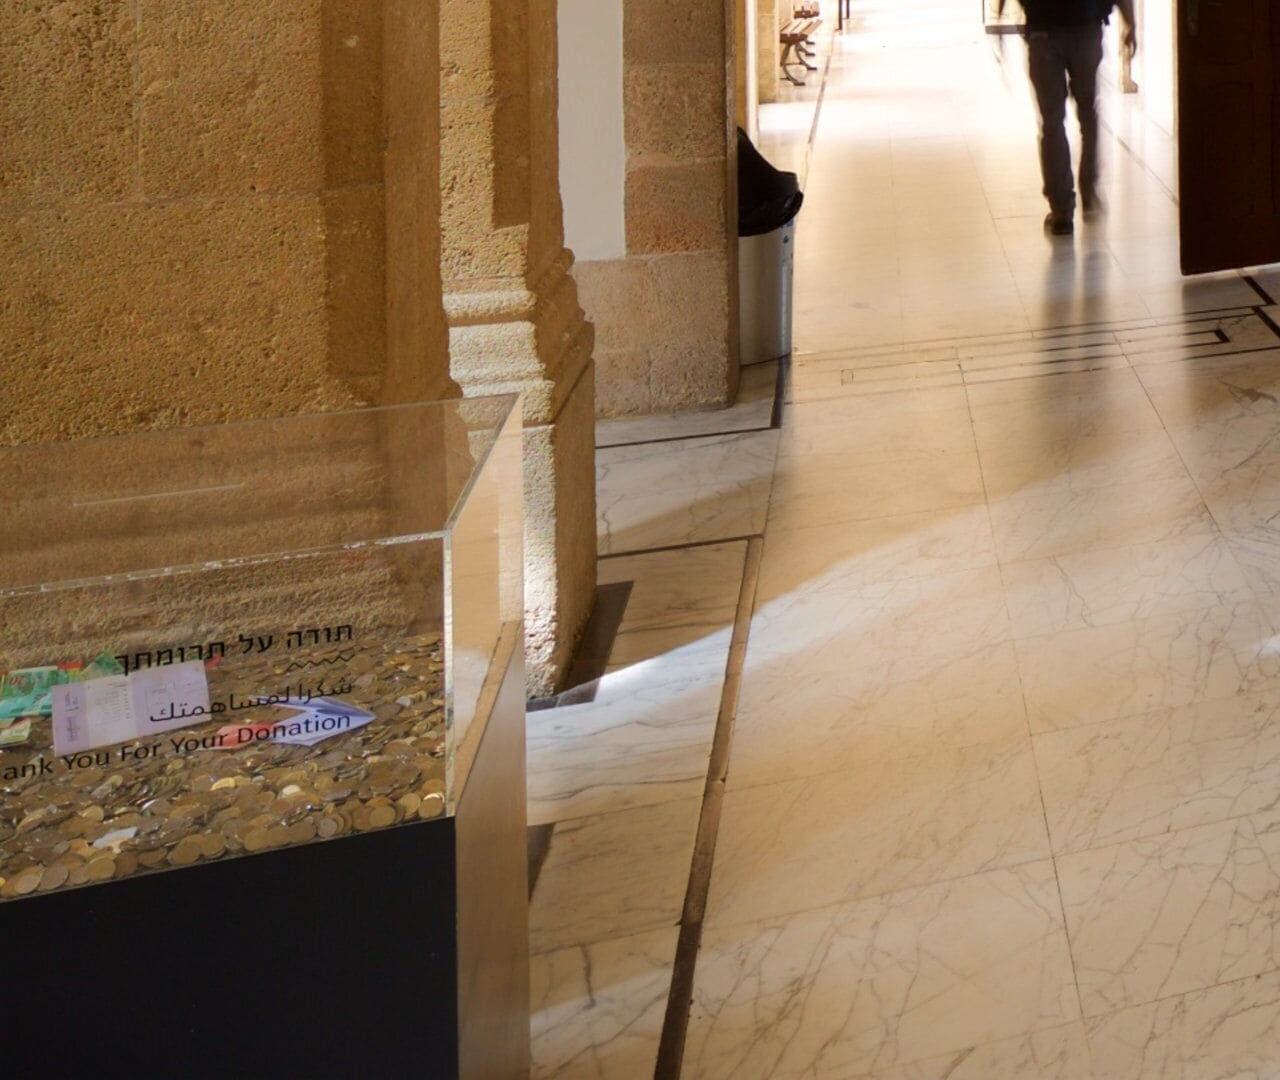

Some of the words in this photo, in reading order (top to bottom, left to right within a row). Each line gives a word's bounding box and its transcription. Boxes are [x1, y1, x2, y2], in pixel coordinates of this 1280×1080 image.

[239, 634, 273, 655] על
[287, 623, 353, 647] תודה
[115, 641, 225, 676] תרומתך
[298, 676, 353, 701] شكرا
[150, 686, 290, 722] لمساهمتك
[63, 752, 110, 771] You
[121, 742, 162, 762] For
[170, 731, 228, 754] Your
[237, 715, 351, 744] Donation
